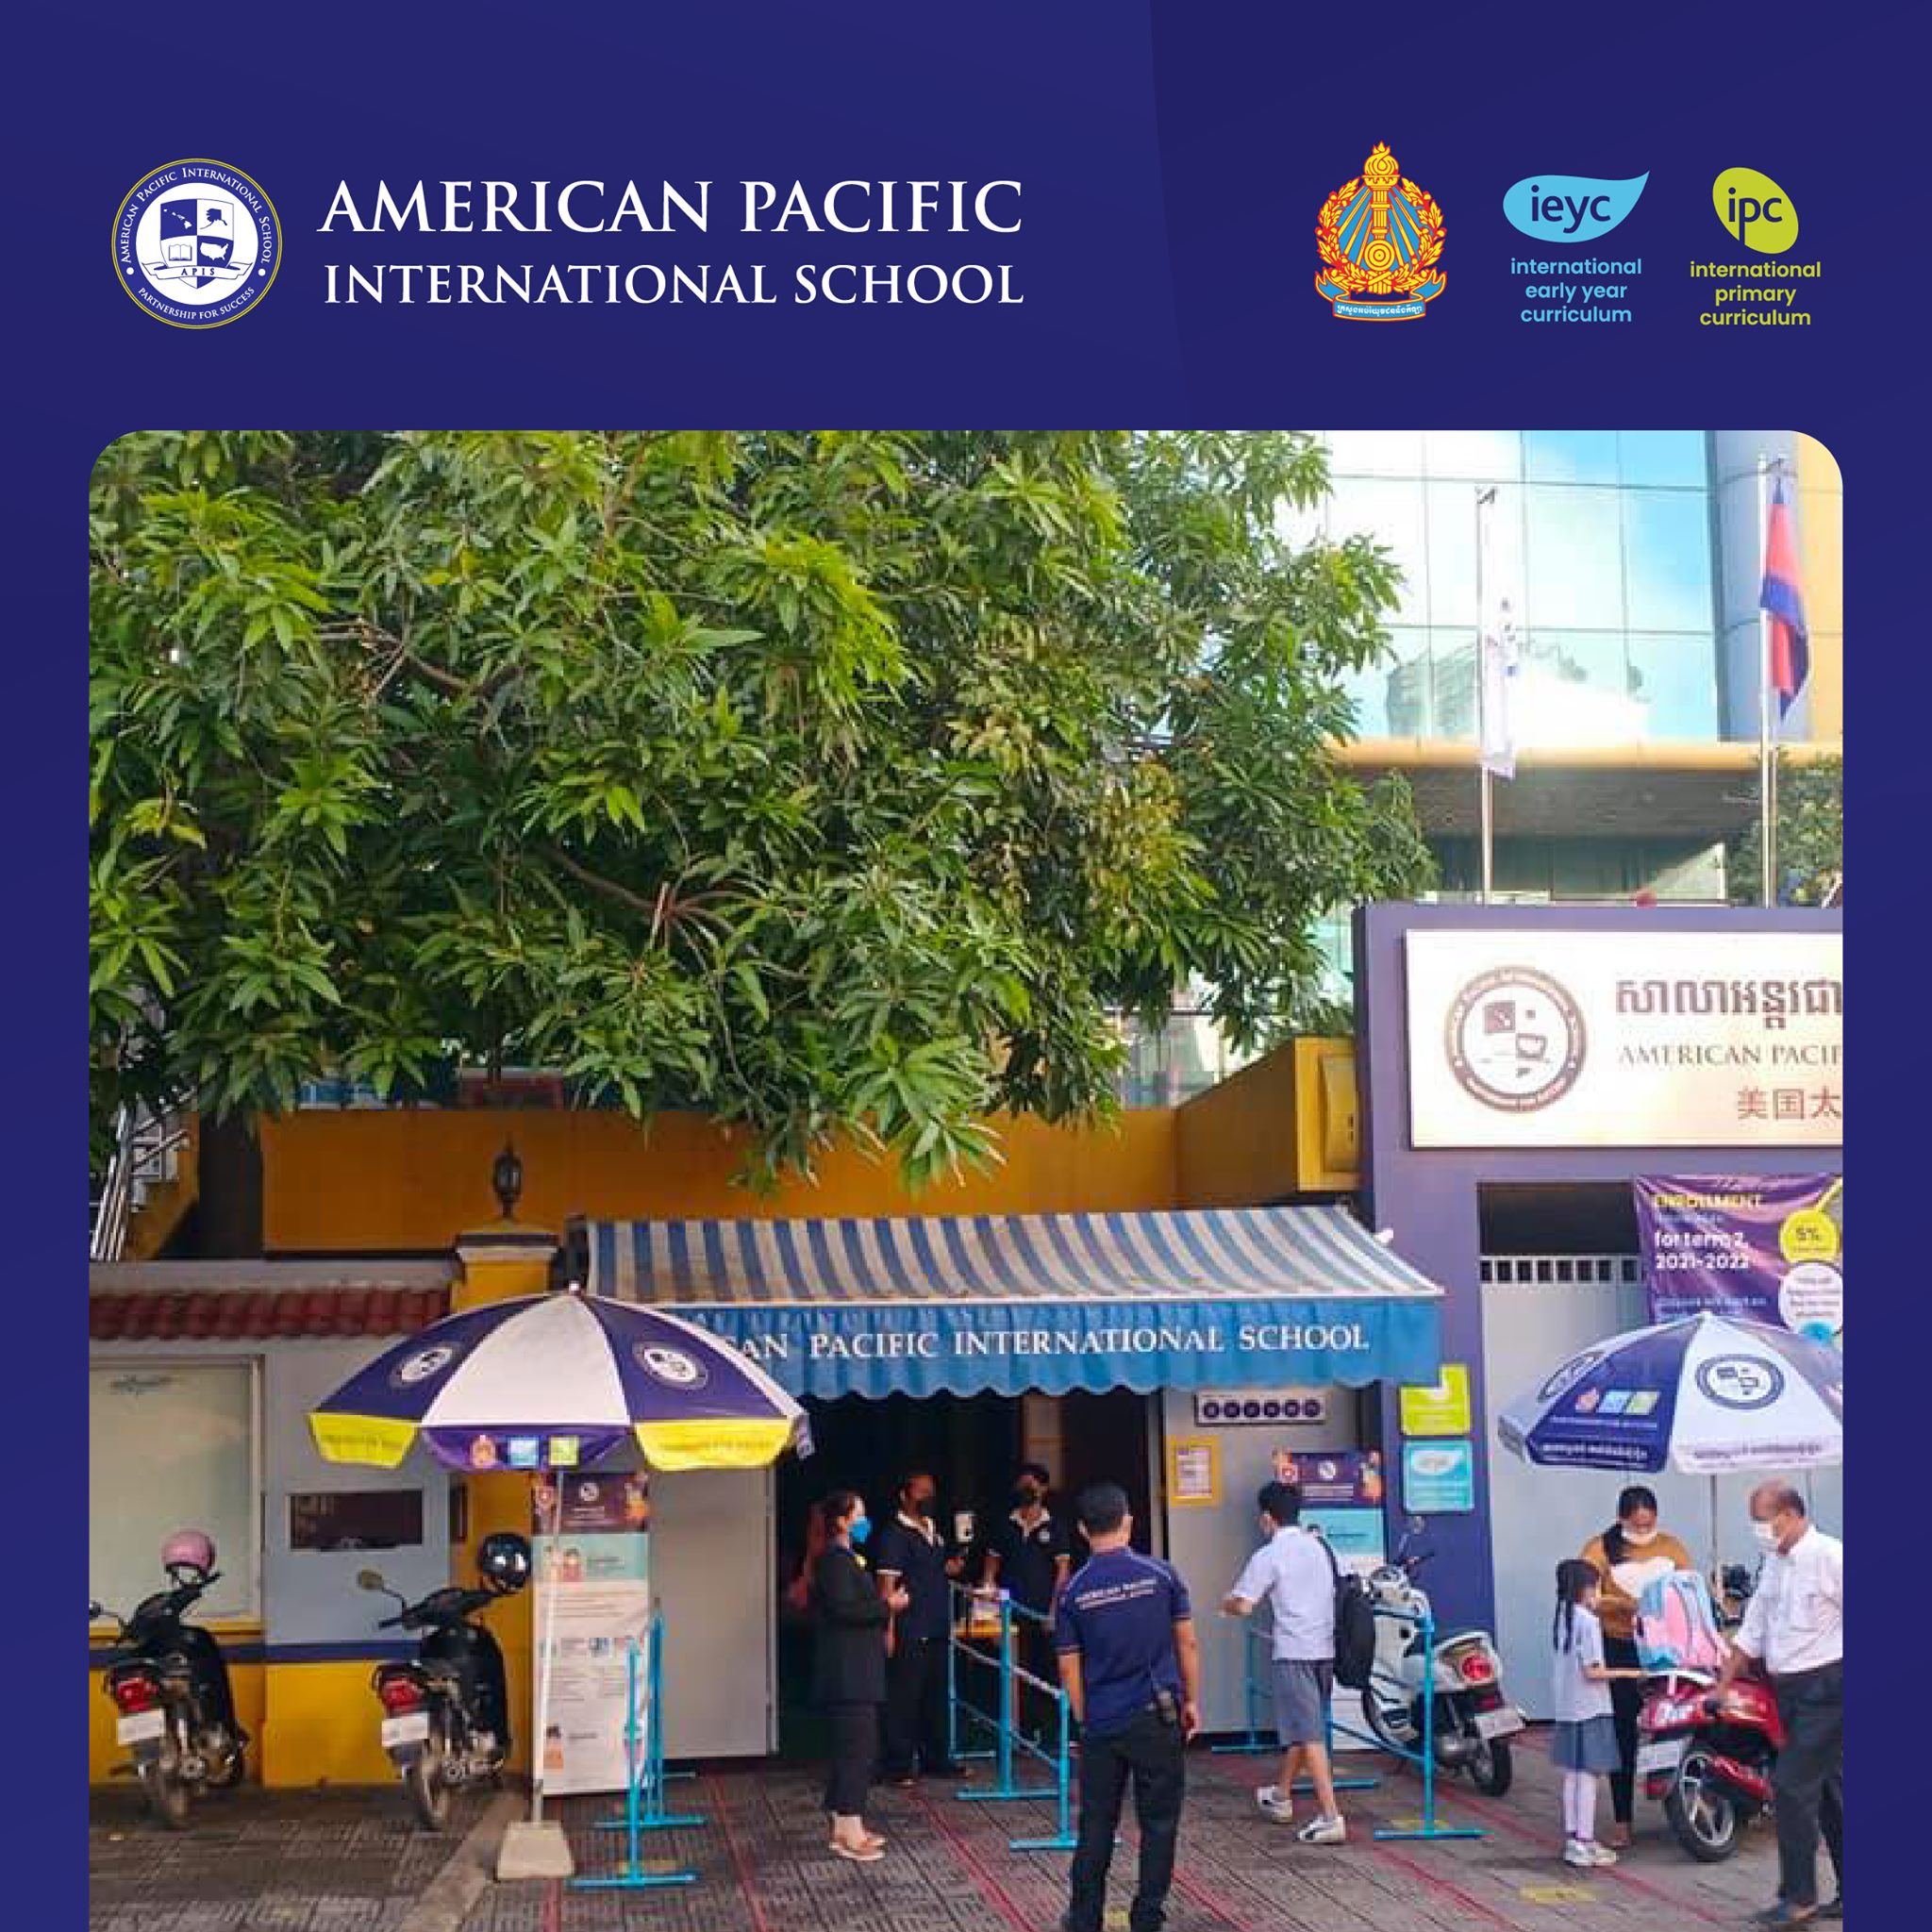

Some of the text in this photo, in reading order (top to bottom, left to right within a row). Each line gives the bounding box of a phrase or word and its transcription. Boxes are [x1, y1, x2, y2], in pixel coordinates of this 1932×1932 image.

[1619, 1043, 1761, 1066] AMERICAN
[808, 1333, 941, 1358] PACIFIC
[954, 1326, 1225, 1356] INTERNATIONAL
[1239, 1324, 1370, 1351] SCHOOL
